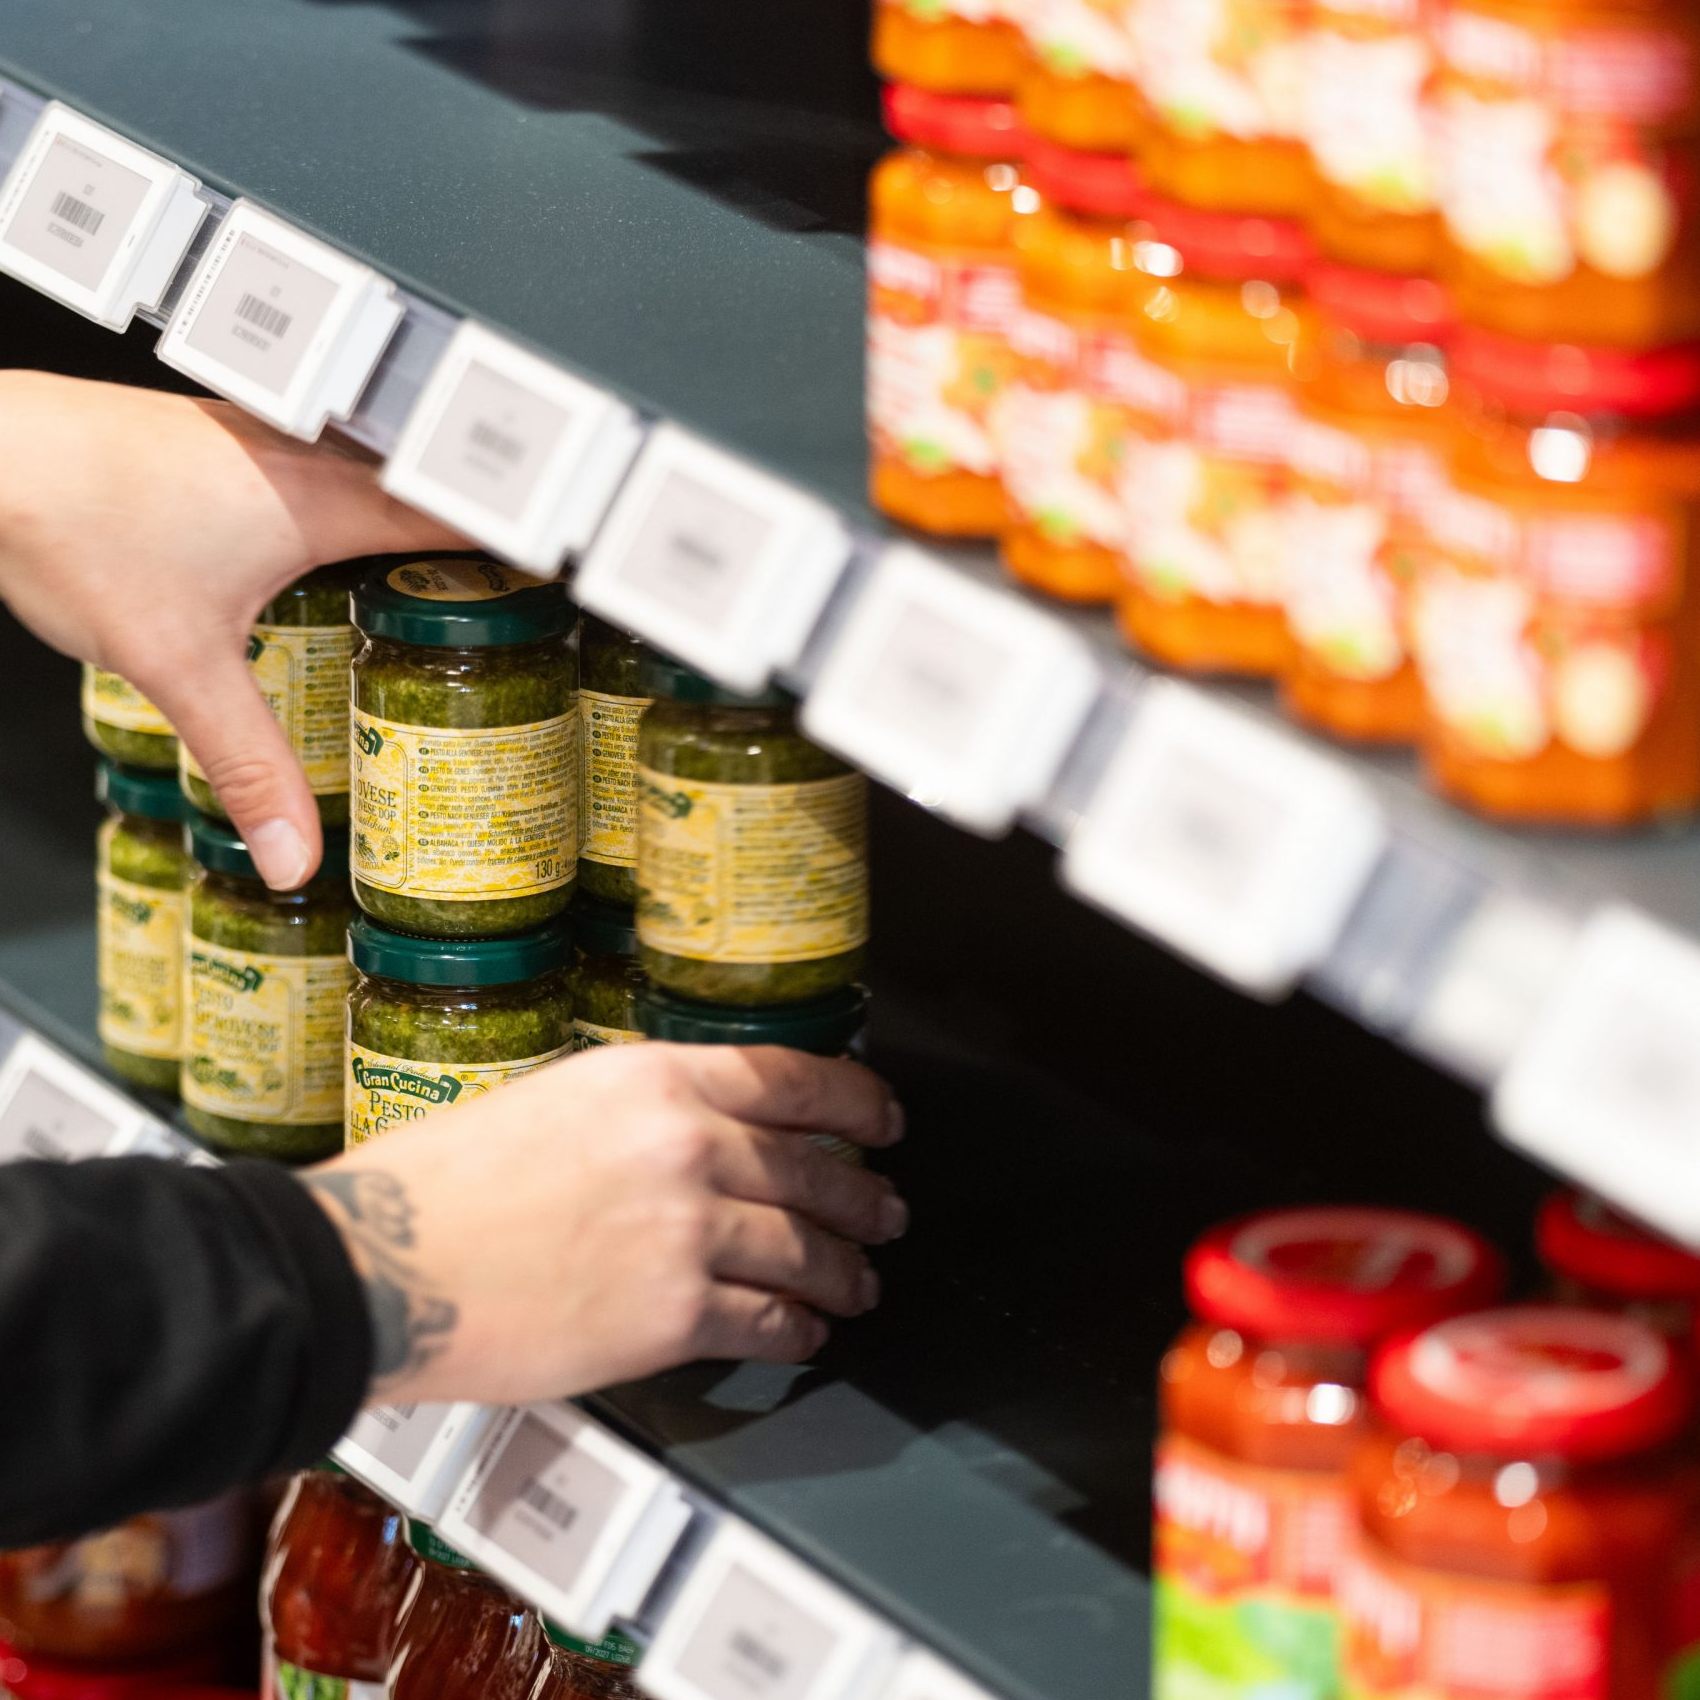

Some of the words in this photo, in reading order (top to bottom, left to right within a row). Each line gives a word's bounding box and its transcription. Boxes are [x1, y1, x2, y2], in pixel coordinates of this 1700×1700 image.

[535, 858, 553, 879] 130
[362, 1069, 390, 1088] Gran
[390, 1072, 440, 1101] Cucina
